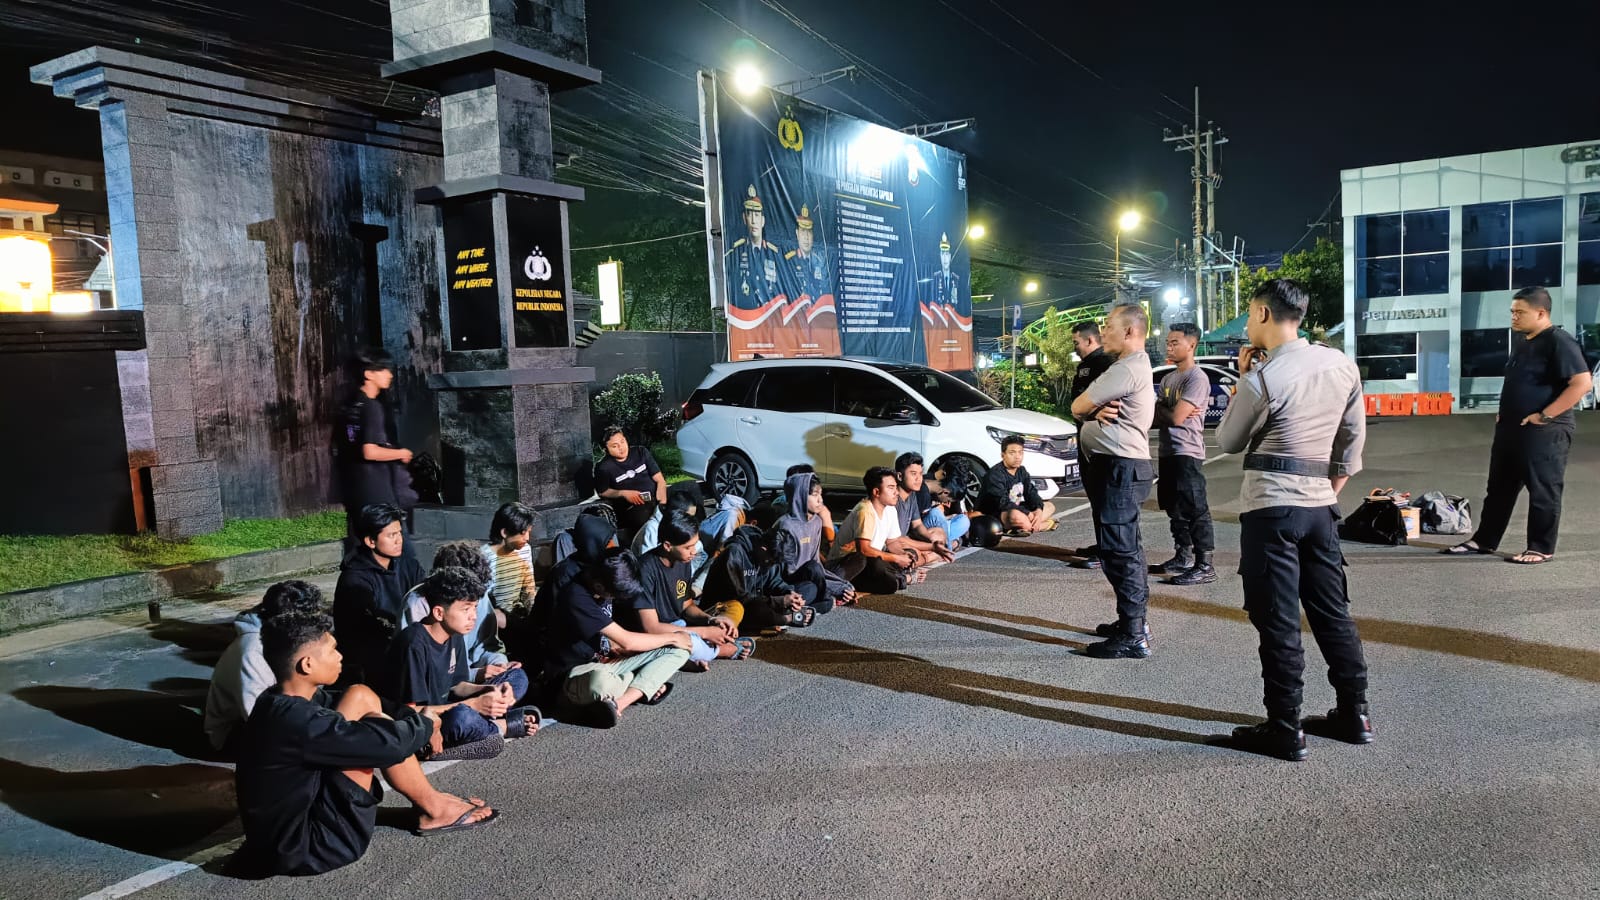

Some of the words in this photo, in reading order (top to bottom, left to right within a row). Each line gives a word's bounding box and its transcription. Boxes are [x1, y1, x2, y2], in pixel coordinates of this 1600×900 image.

[457, 250, 470, 260] ANY
[470, 247, 486, 258] TIME
[455, 264, 469, 275] ANY
[468, 262, 489, 273] WHERE
[453, 279, 466, 290] ANY
[465, 278, 493, 288] WEATHER
[515, 288, 543, 298] KEPOLISIAN
[543, 289, 562, 299] NEGARA
[516, 301, 540, 311] REPUBLIK
[540, 302, 564, 312] INDONESIA
